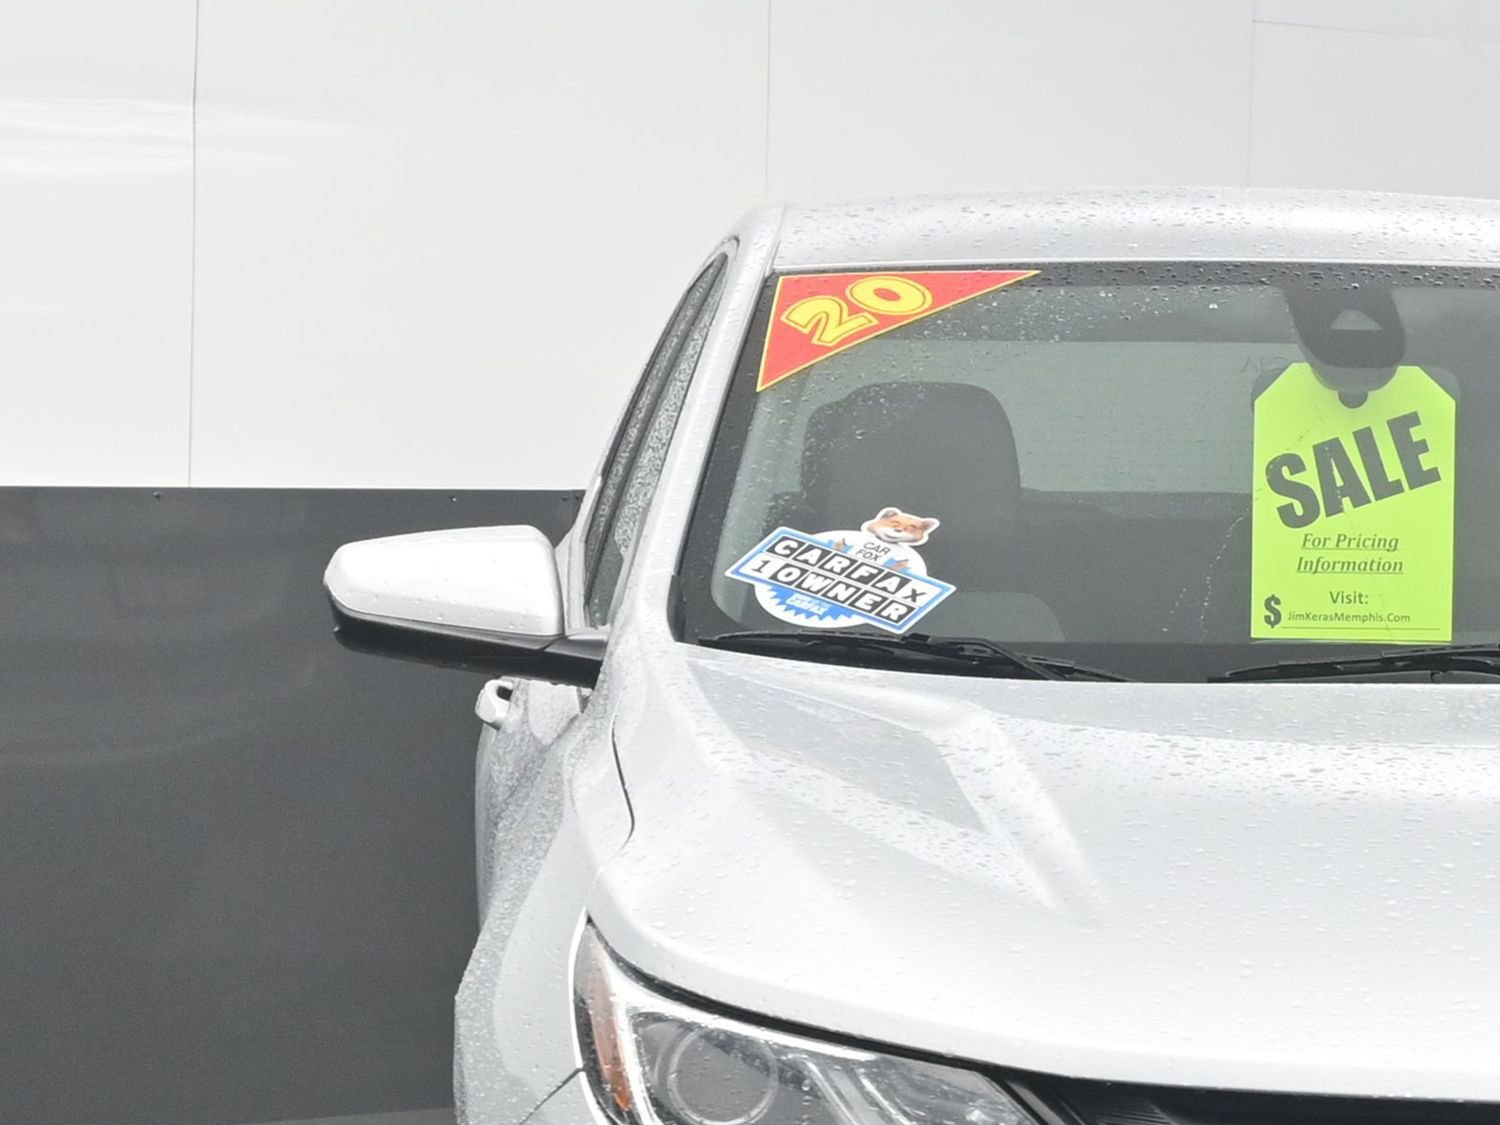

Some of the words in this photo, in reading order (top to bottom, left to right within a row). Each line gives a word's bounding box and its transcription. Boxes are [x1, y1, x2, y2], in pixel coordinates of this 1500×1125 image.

[782, 276, 932, 346] 20
[1265, 411, 1442, 529] SALE
[863, 541, 891, 555] CAR
[1302, 533, 1331, 549] For
[1335, 533, 1399, 552] Pricing
[855, 548, 882, 561] FOX
[773, 539, 929, 603] CARFAX
[1296, 556, 1404, 574] Information
[751, 558, 773, 574] 1
[776, 564, 909, 621] OWNER
[1329, 591, 1369, 604] Visit:
[1288, 611, 1411, 623] JimKerasMemphis.Com
